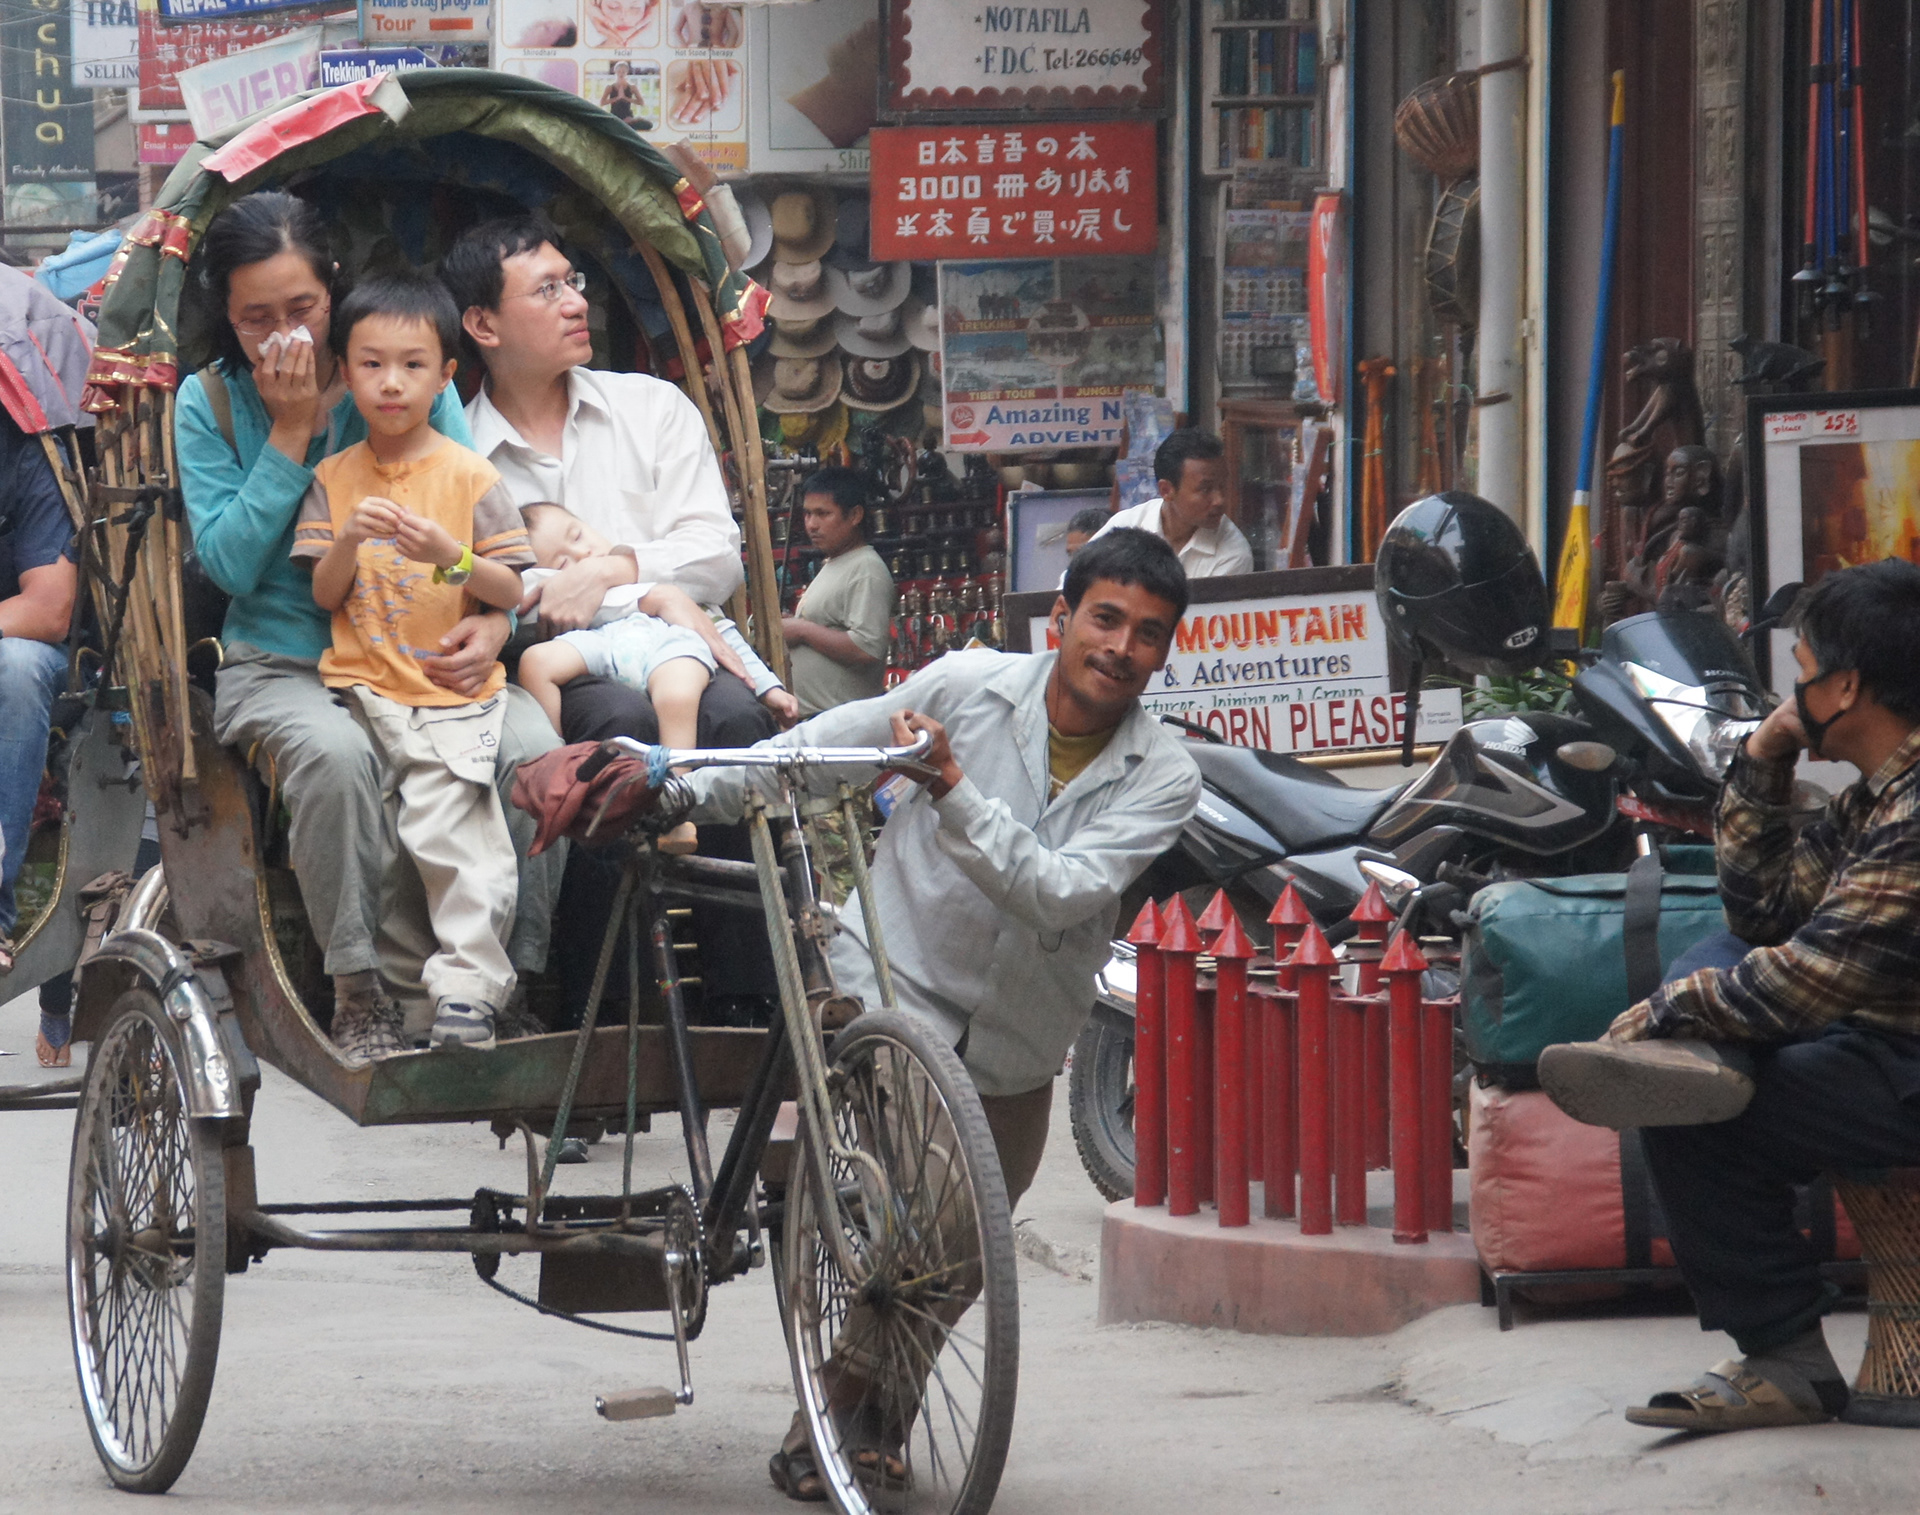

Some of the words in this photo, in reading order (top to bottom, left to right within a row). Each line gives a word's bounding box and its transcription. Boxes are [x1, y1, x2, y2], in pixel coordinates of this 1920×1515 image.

[371, 13, 416, 31] Tour
[984, 5, 1091, 34] NOTAFILA
[322, 62, 367, 84] Trekking
[1005, 388, 1036, 400] TOUR
[985, 402, 1092, 426] Amazing
[1174, 603, 1368, 654] MOUNTAIN
[1191, 654, 1351, 686] Adventures
[1290, 695, 1408, 750] PLEASE
[1482, 741, 1527, 756] HONDA
